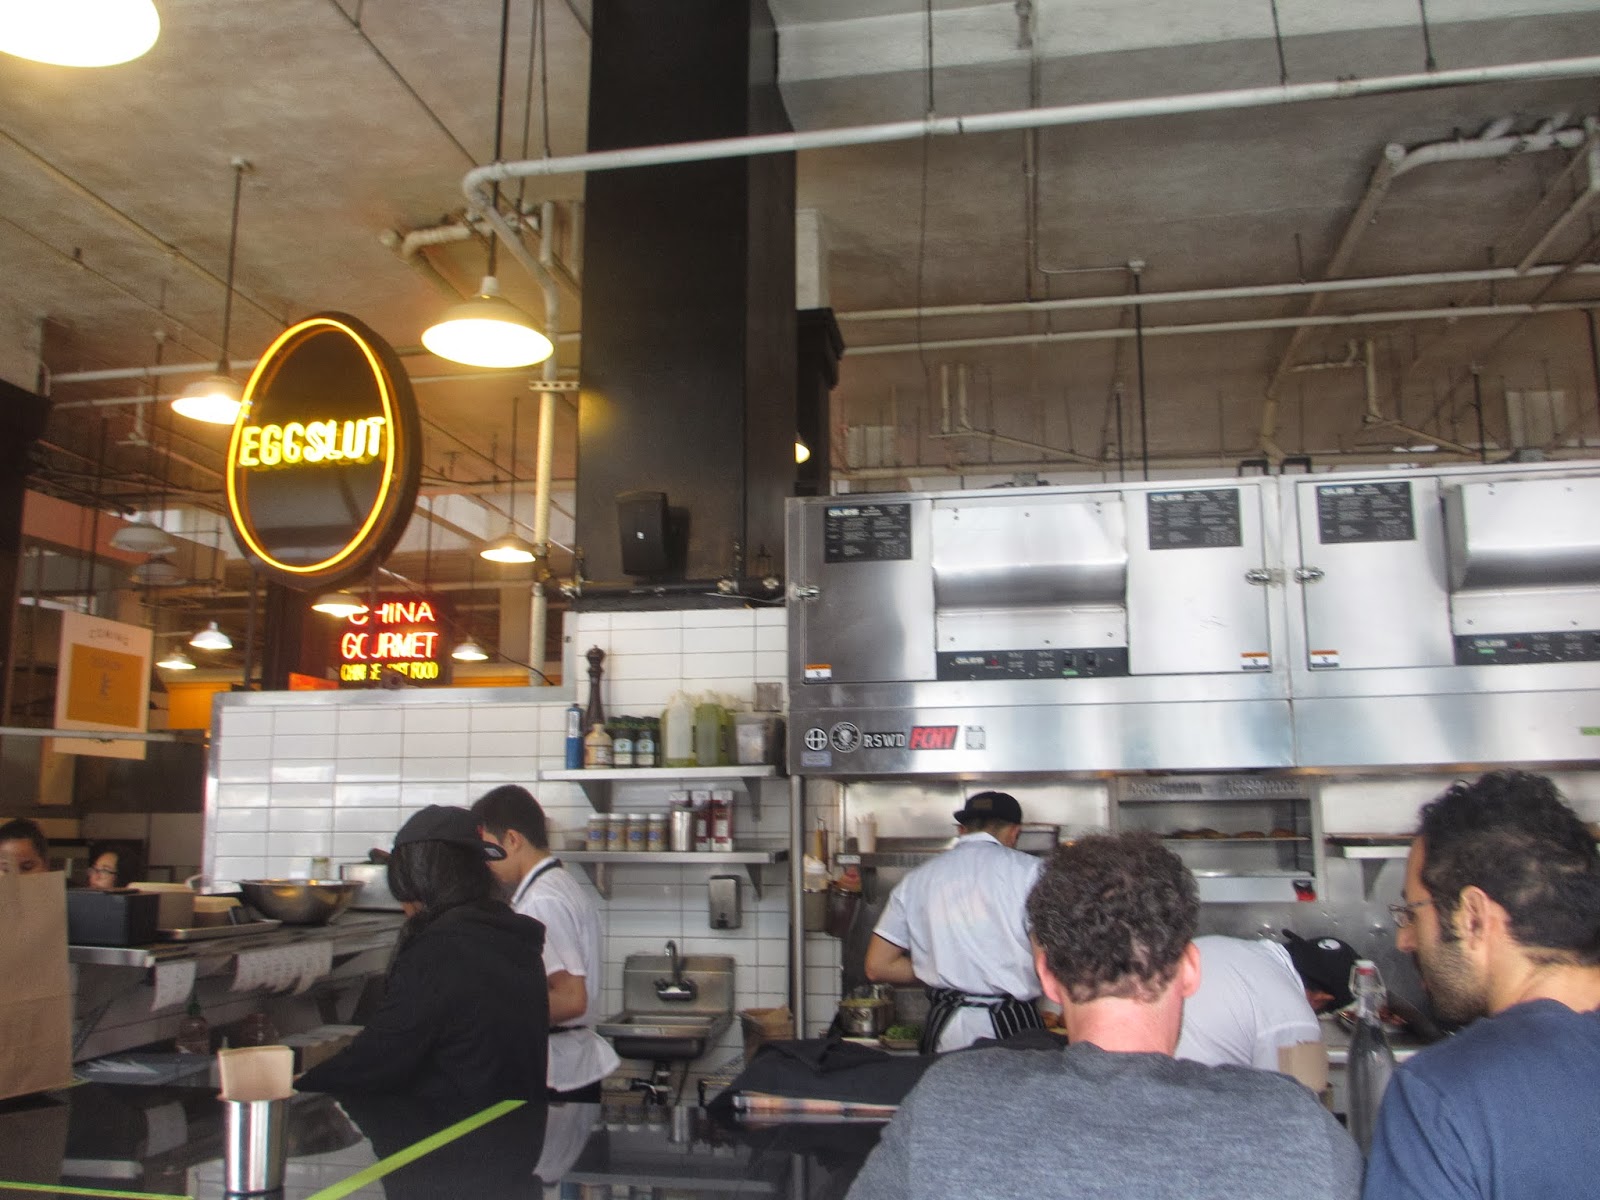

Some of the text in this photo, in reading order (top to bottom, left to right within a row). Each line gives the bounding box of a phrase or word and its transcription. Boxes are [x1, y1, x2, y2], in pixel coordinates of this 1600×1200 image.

[239, 416, 387, 467] EGGSLUT
[348, 602, 436, 626] CHINA
[409, 661, 439, 679] FOOD
